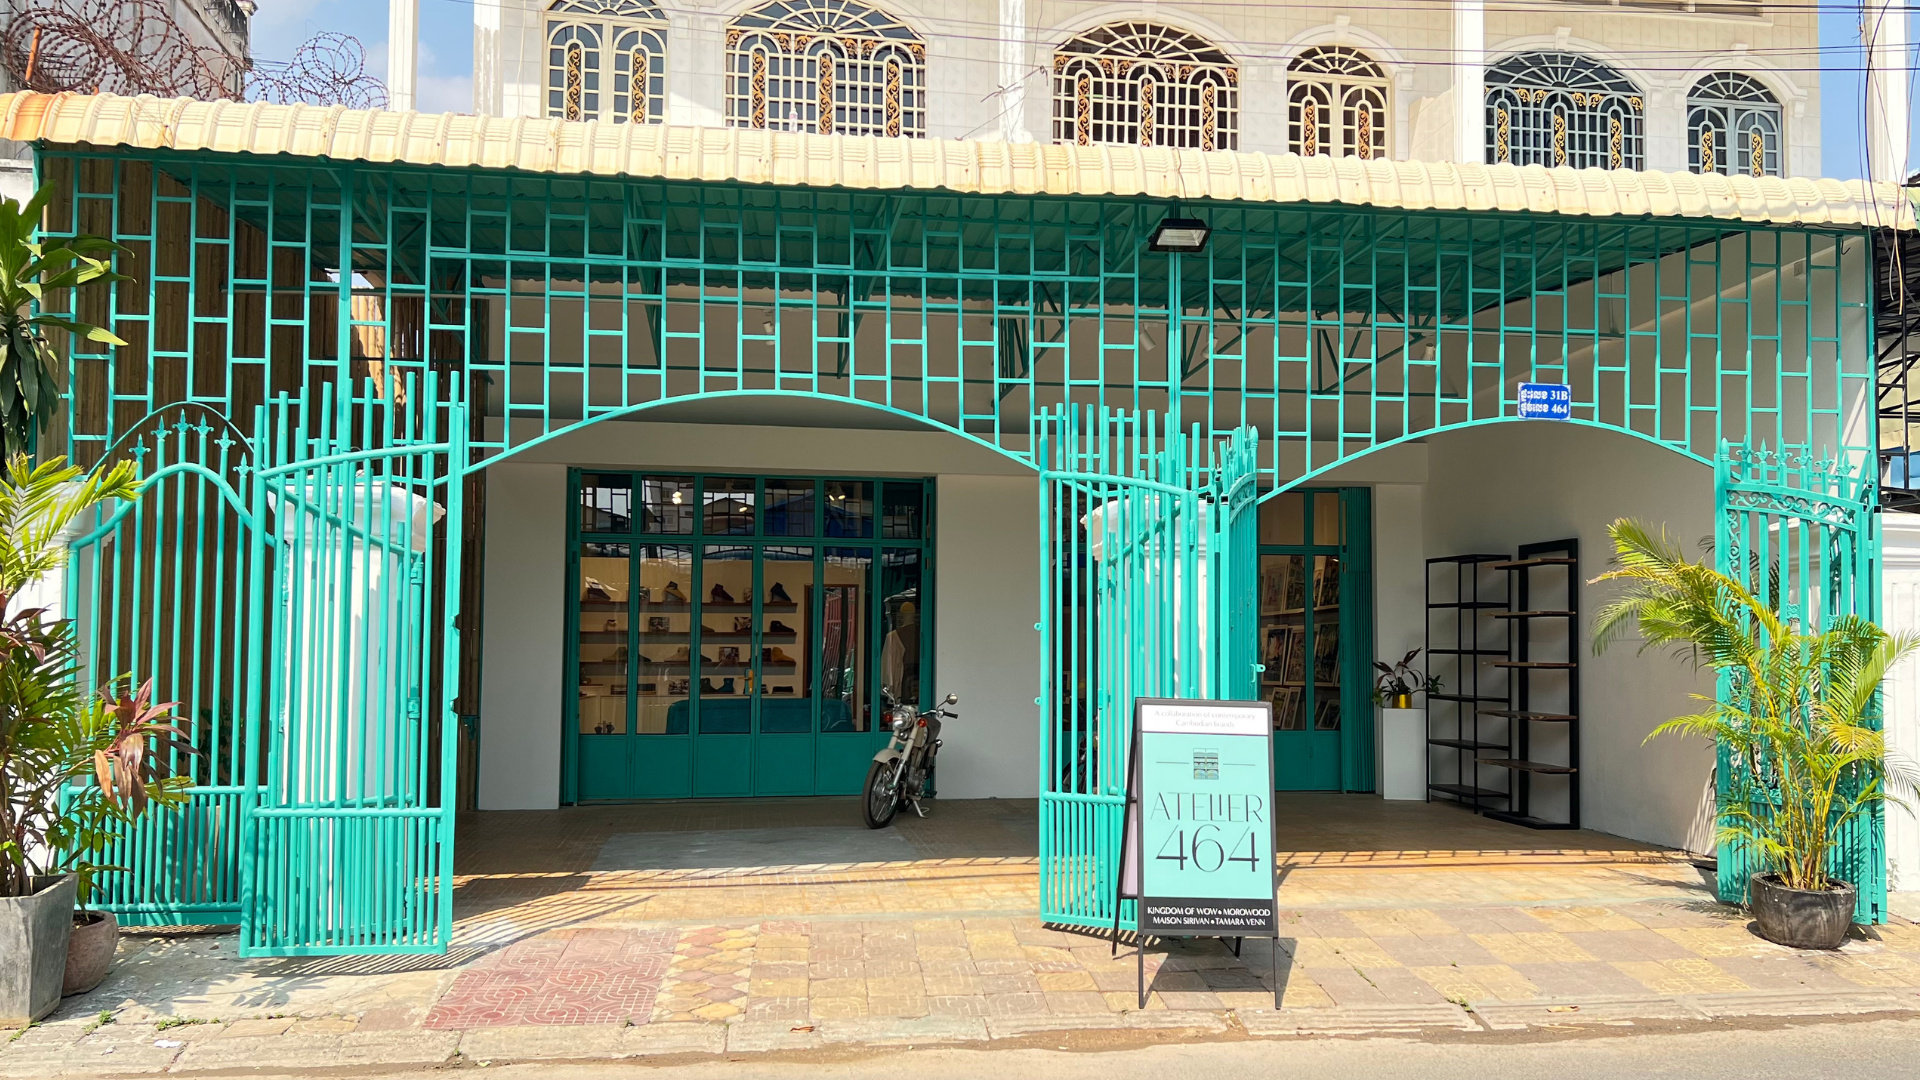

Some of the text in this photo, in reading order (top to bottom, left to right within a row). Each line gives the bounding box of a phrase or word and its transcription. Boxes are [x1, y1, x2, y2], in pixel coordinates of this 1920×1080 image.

[1550, 390, 1568, 400] 31B
[1551, 403, 1568, 413] 464
[1161, 710, 1202, 718] collaboration
[1211, 712, 1256, 720] contemporary
[1175, 719, 1235, 728] Cambodian brands
[1150, 792, 1263, 823] ATELIER
[1155, 823, 1260, 873] 464
[1147, 906, 1271, 917] KINGDOM OF WOW MOROWOOD
[1152, 916, 1266, 926] MAISON SIRIVAN TAMARA VENN
